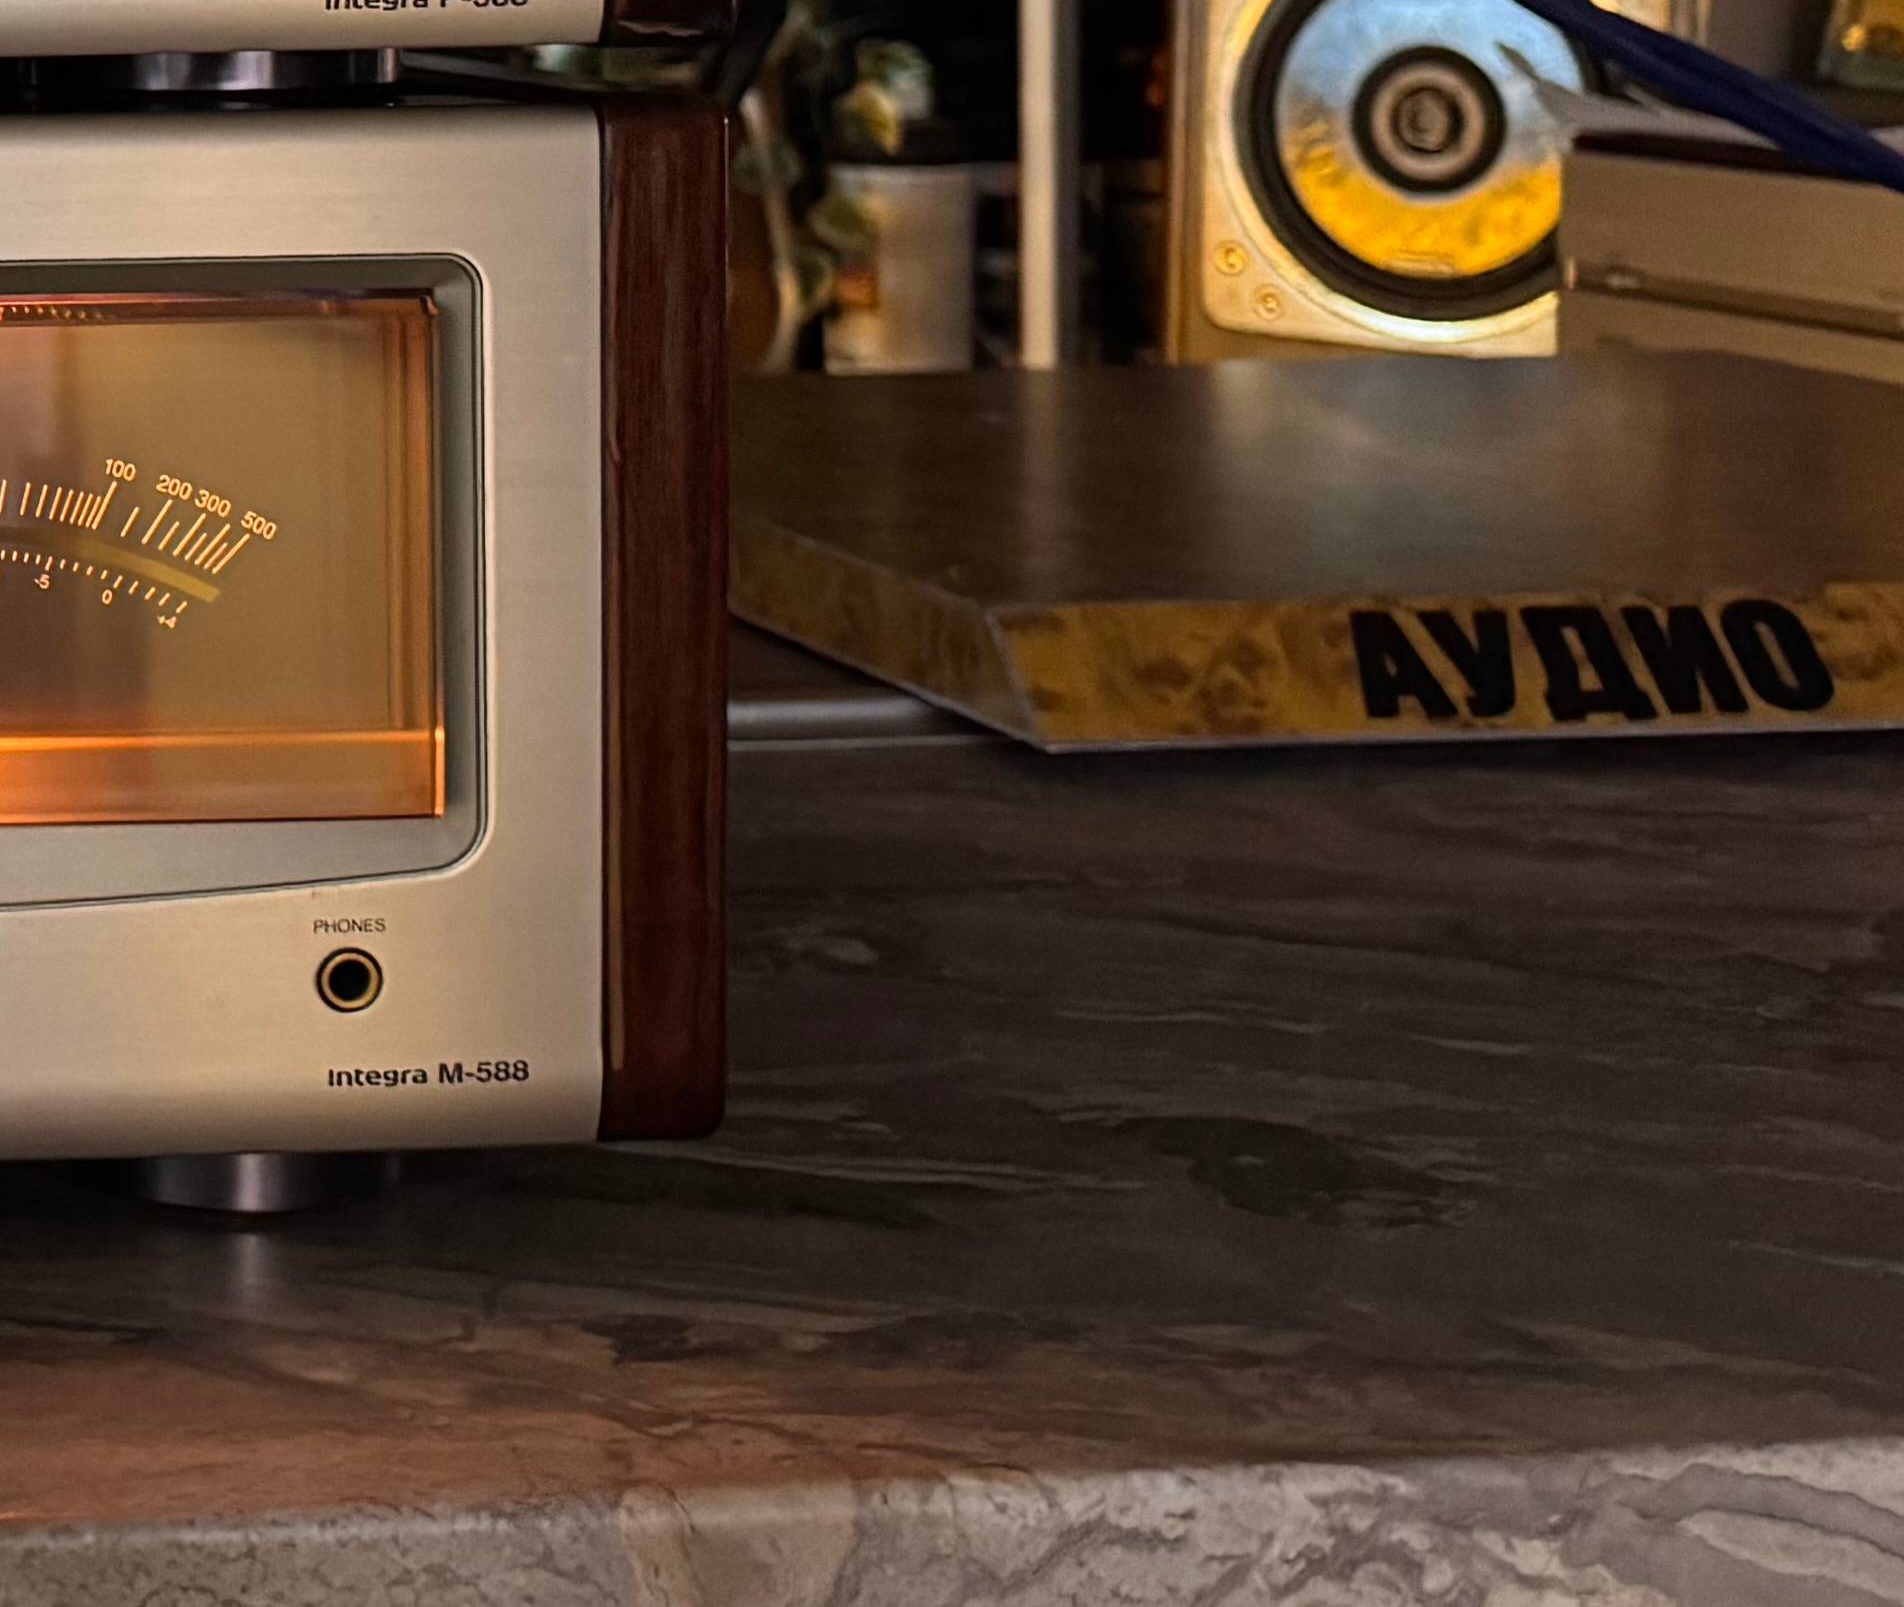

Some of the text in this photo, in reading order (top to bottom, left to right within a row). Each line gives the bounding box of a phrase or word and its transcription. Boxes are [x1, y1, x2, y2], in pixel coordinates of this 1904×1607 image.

[105, 458, 136, 482] 100
[156, 474, 192, 500] 200
[195, 489, 231, 517] 300
[241, 511, 277, 540] 500
[34, 574, 50, 590] -5
[102, 589, 113, 605] 0
[1349, 599, 1835, 723] АУДИО
[313, 918, 386, 934] PHONES
[328, 1060, 529, 1086] Integra M-588
